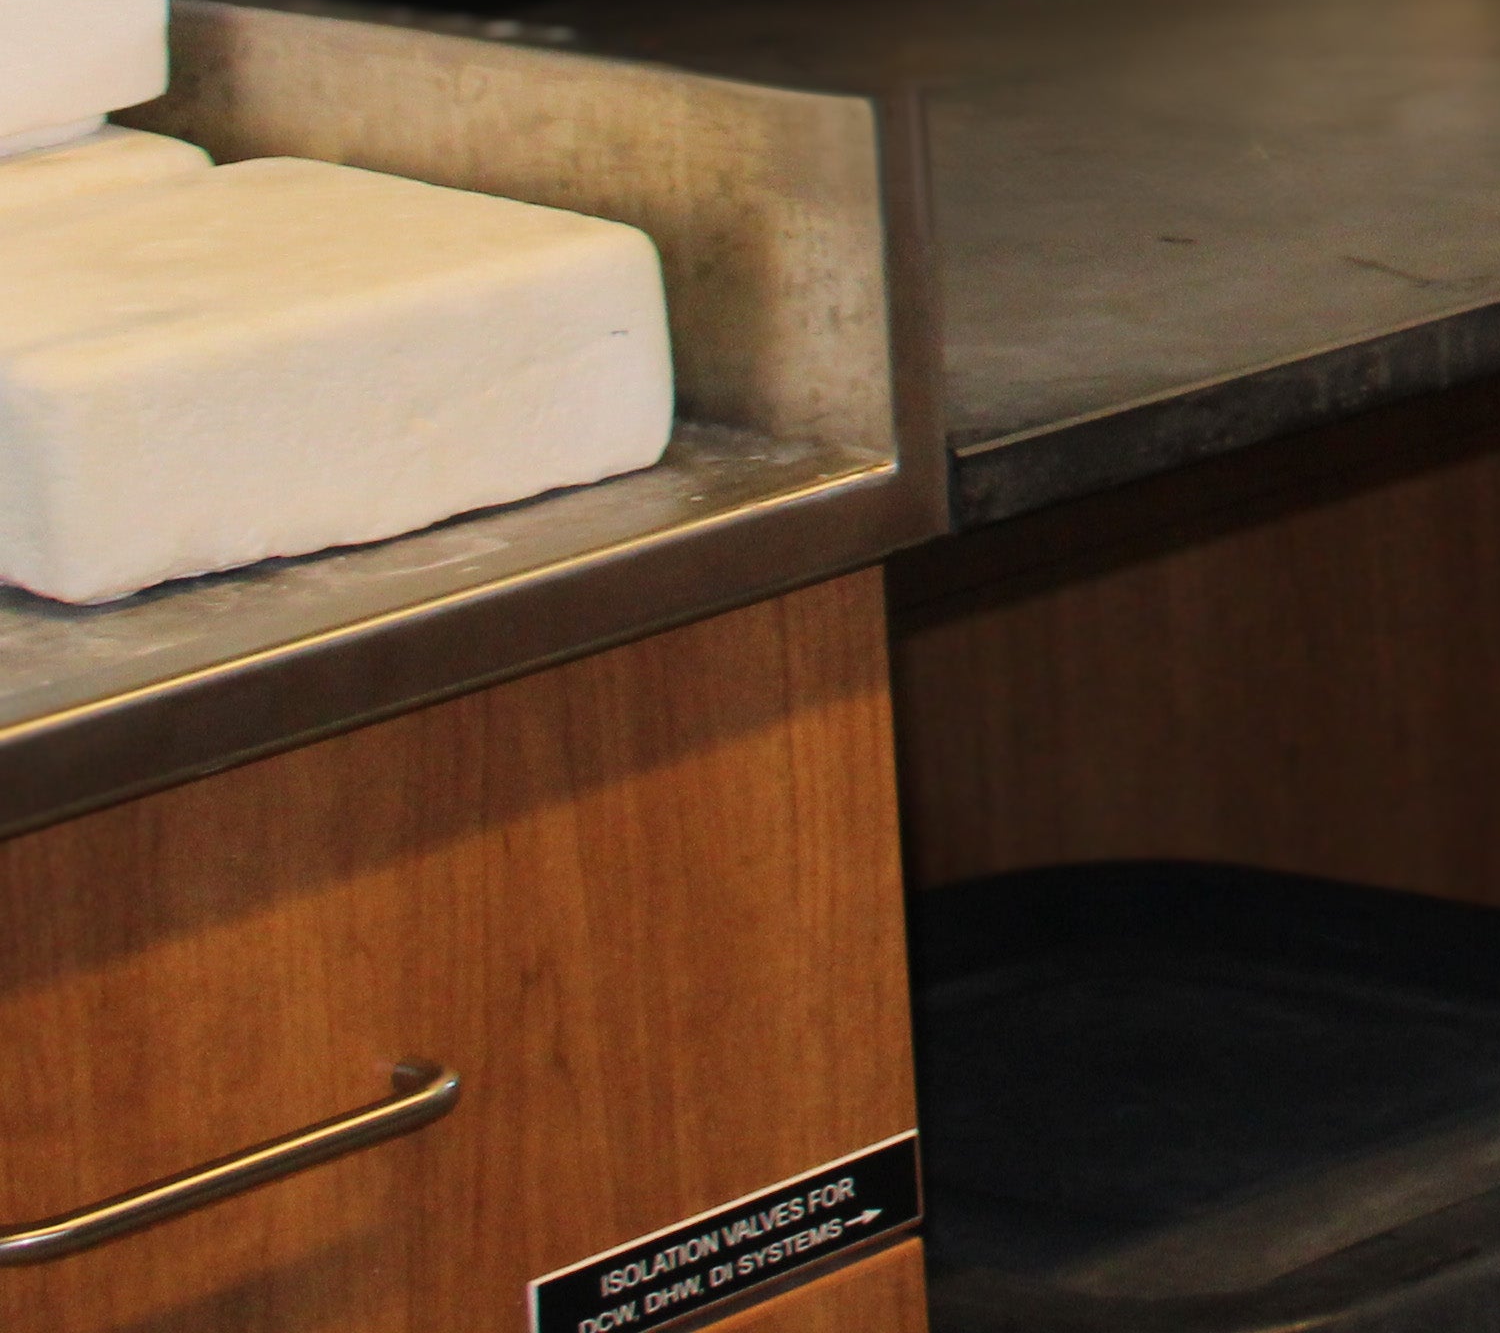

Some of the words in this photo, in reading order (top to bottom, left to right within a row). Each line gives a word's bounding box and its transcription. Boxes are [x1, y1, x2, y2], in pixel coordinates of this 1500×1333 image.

[601, 1230, 719, 1298] ISOLATION
[721, 1197, 805, 1247] VALVES
[807, 1177, 856, 1214] FOR
[709, 1262, 734, 1288] DI
[736, 1217, 843, 1275] SYSTEMS
